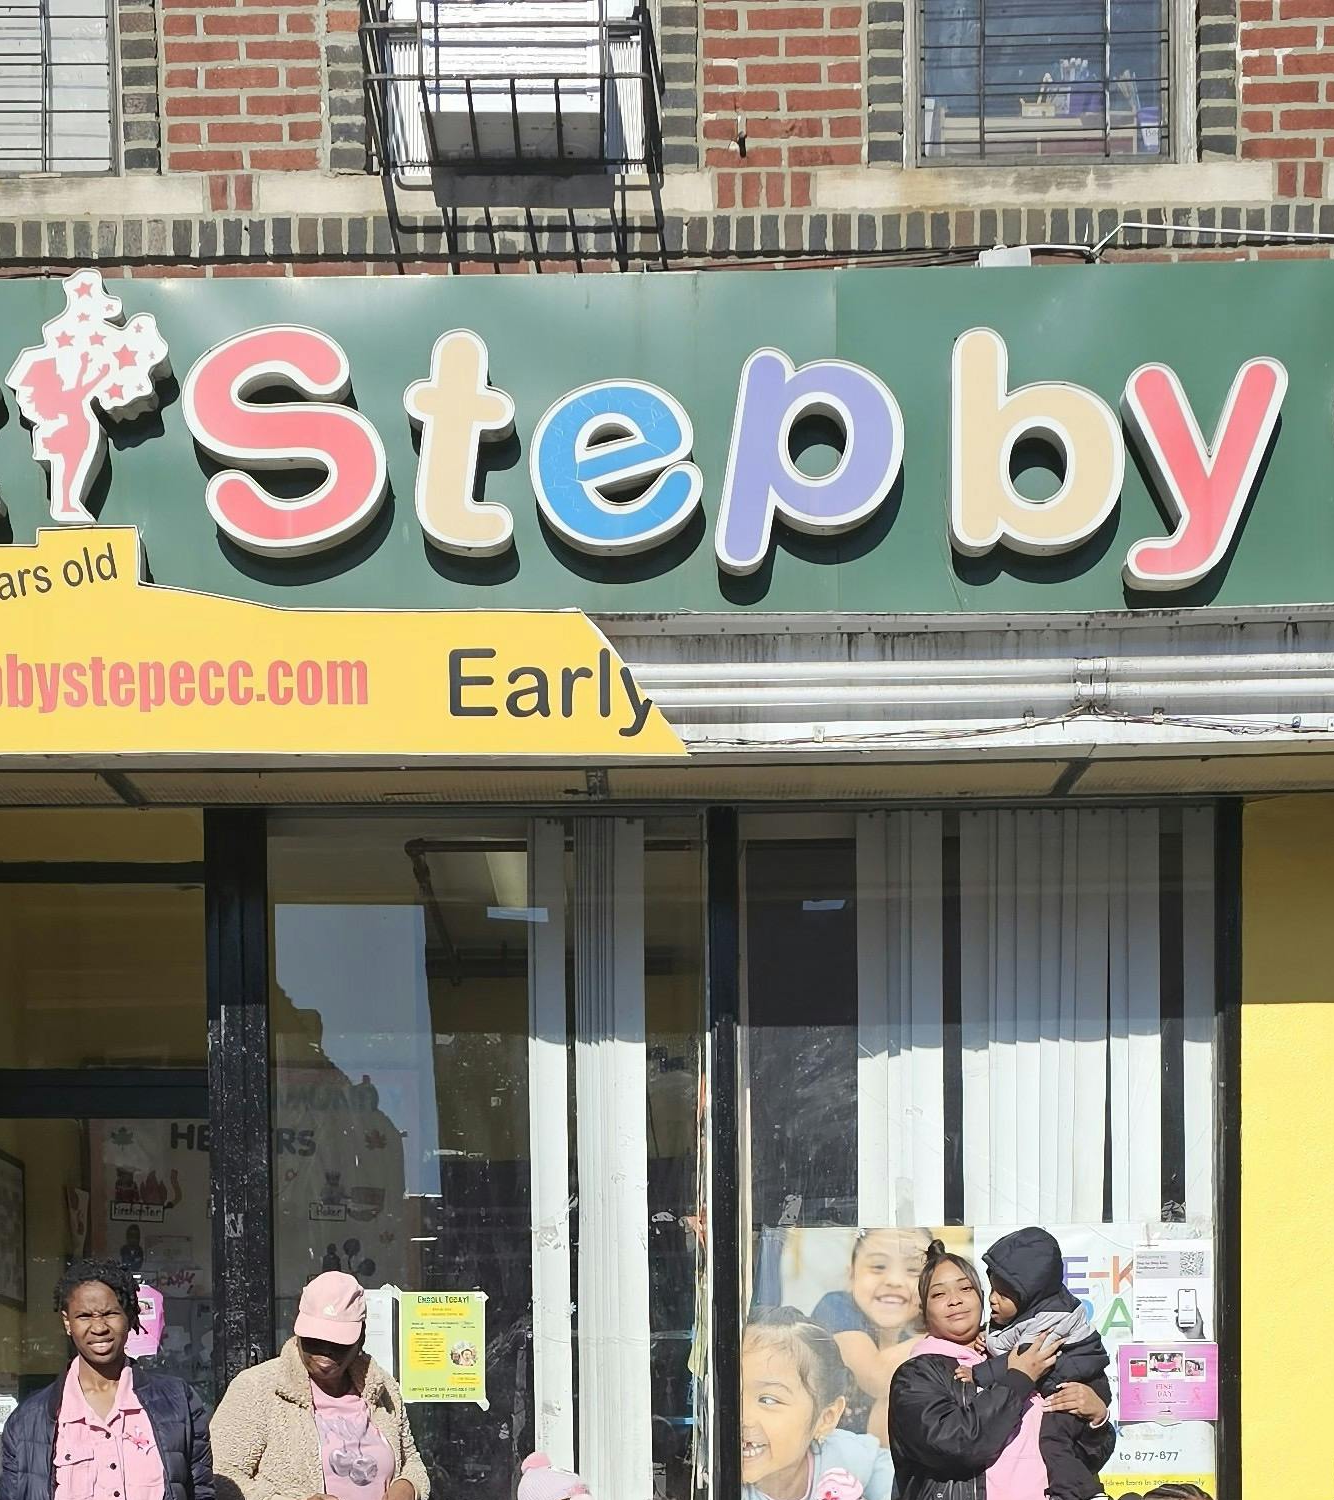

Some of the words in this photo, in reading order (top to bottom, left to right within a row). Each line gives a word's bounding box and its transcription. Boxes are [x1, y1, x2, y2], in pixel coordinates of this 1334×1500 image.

[182, 324, 905, 578] Step
[950, 326, 1289, 592] by
[61, 542, 120, 588] old
[447, 646, 654, 738] Early
[1119, 1451, 1131, 1461] to
[1135, 1450, 1179, 1461] 877-877
